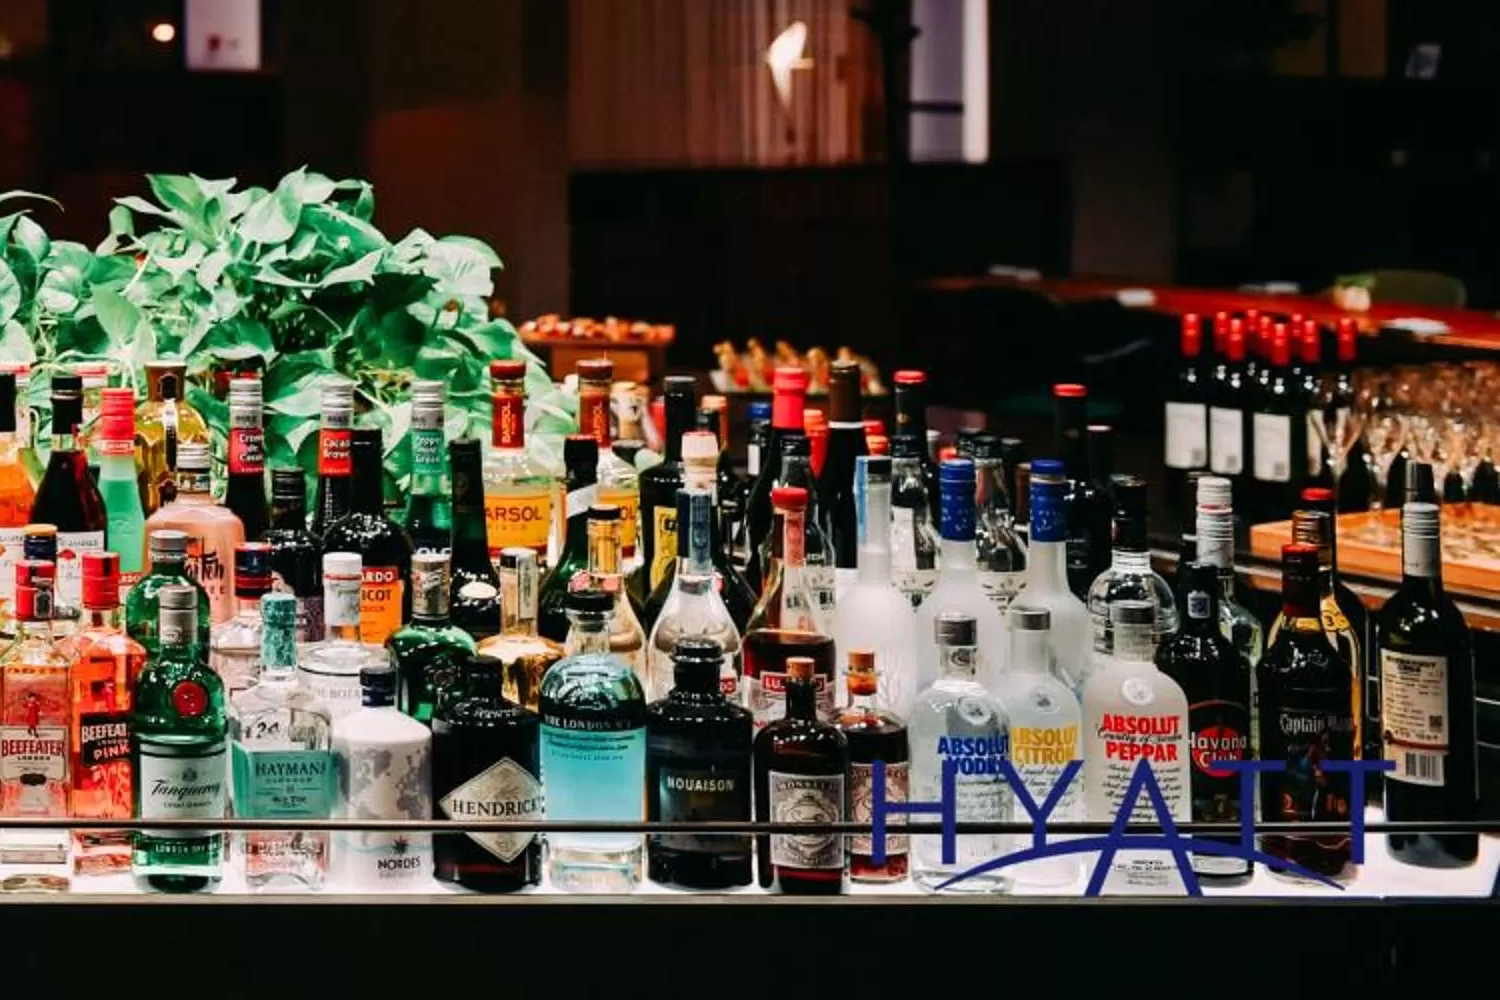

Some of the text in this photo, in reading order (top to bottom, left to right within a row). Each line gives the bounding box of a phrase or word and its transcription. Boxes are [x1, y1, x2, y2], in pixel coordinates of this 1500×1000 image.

[82, 723, 127, 741] BEEFEAT
[1102, 713, 1181, 736] ABSOLUT
[2, 739, 64, 757] BEEFEATER
[1105, 742, 1179, 762] PEPPAR
